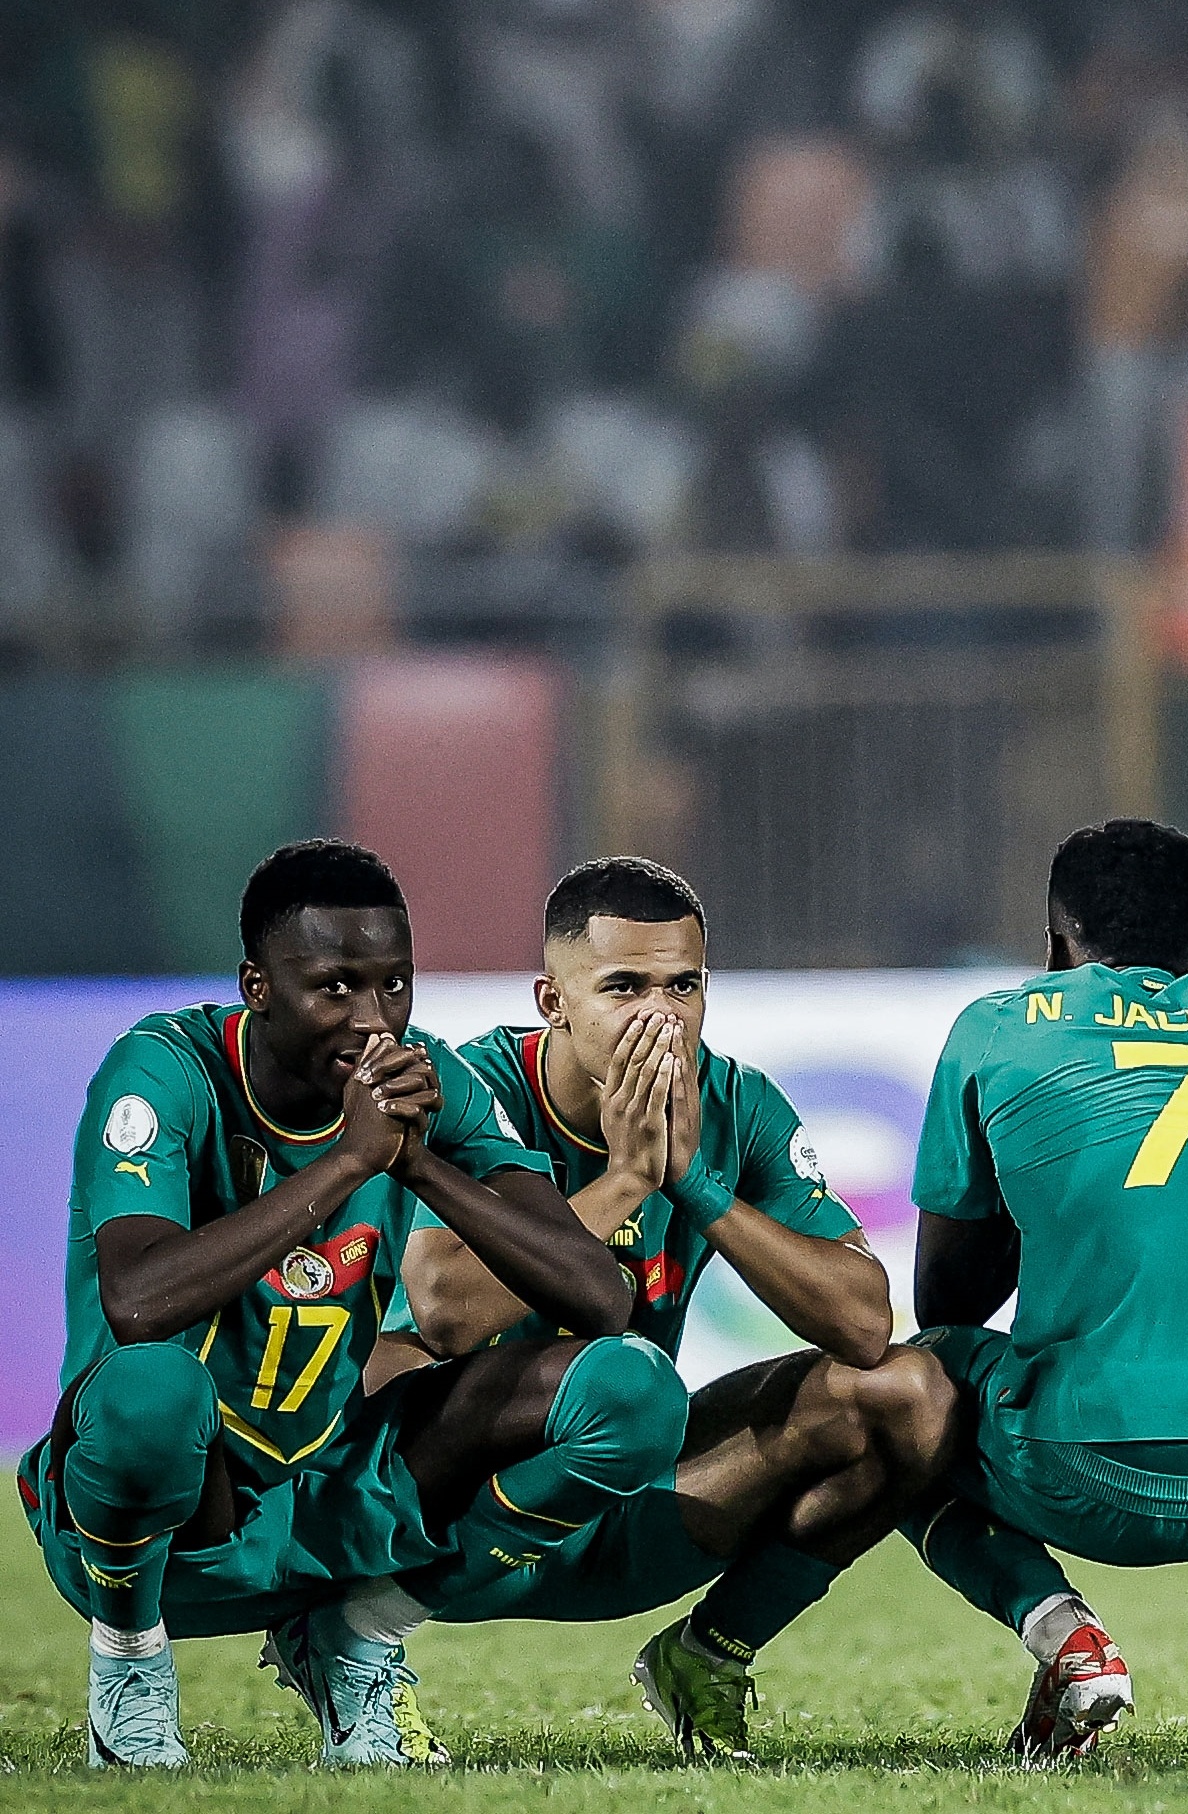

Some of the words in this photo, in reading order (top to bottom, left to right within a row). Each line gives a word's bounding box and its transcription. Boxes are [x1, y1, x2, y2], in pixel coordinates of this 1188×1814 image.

[1026, 992, 1073, 1025] N.
[340, 1241, 368, 1265] LIONS
[250, 1305, 349, 1412] 17
